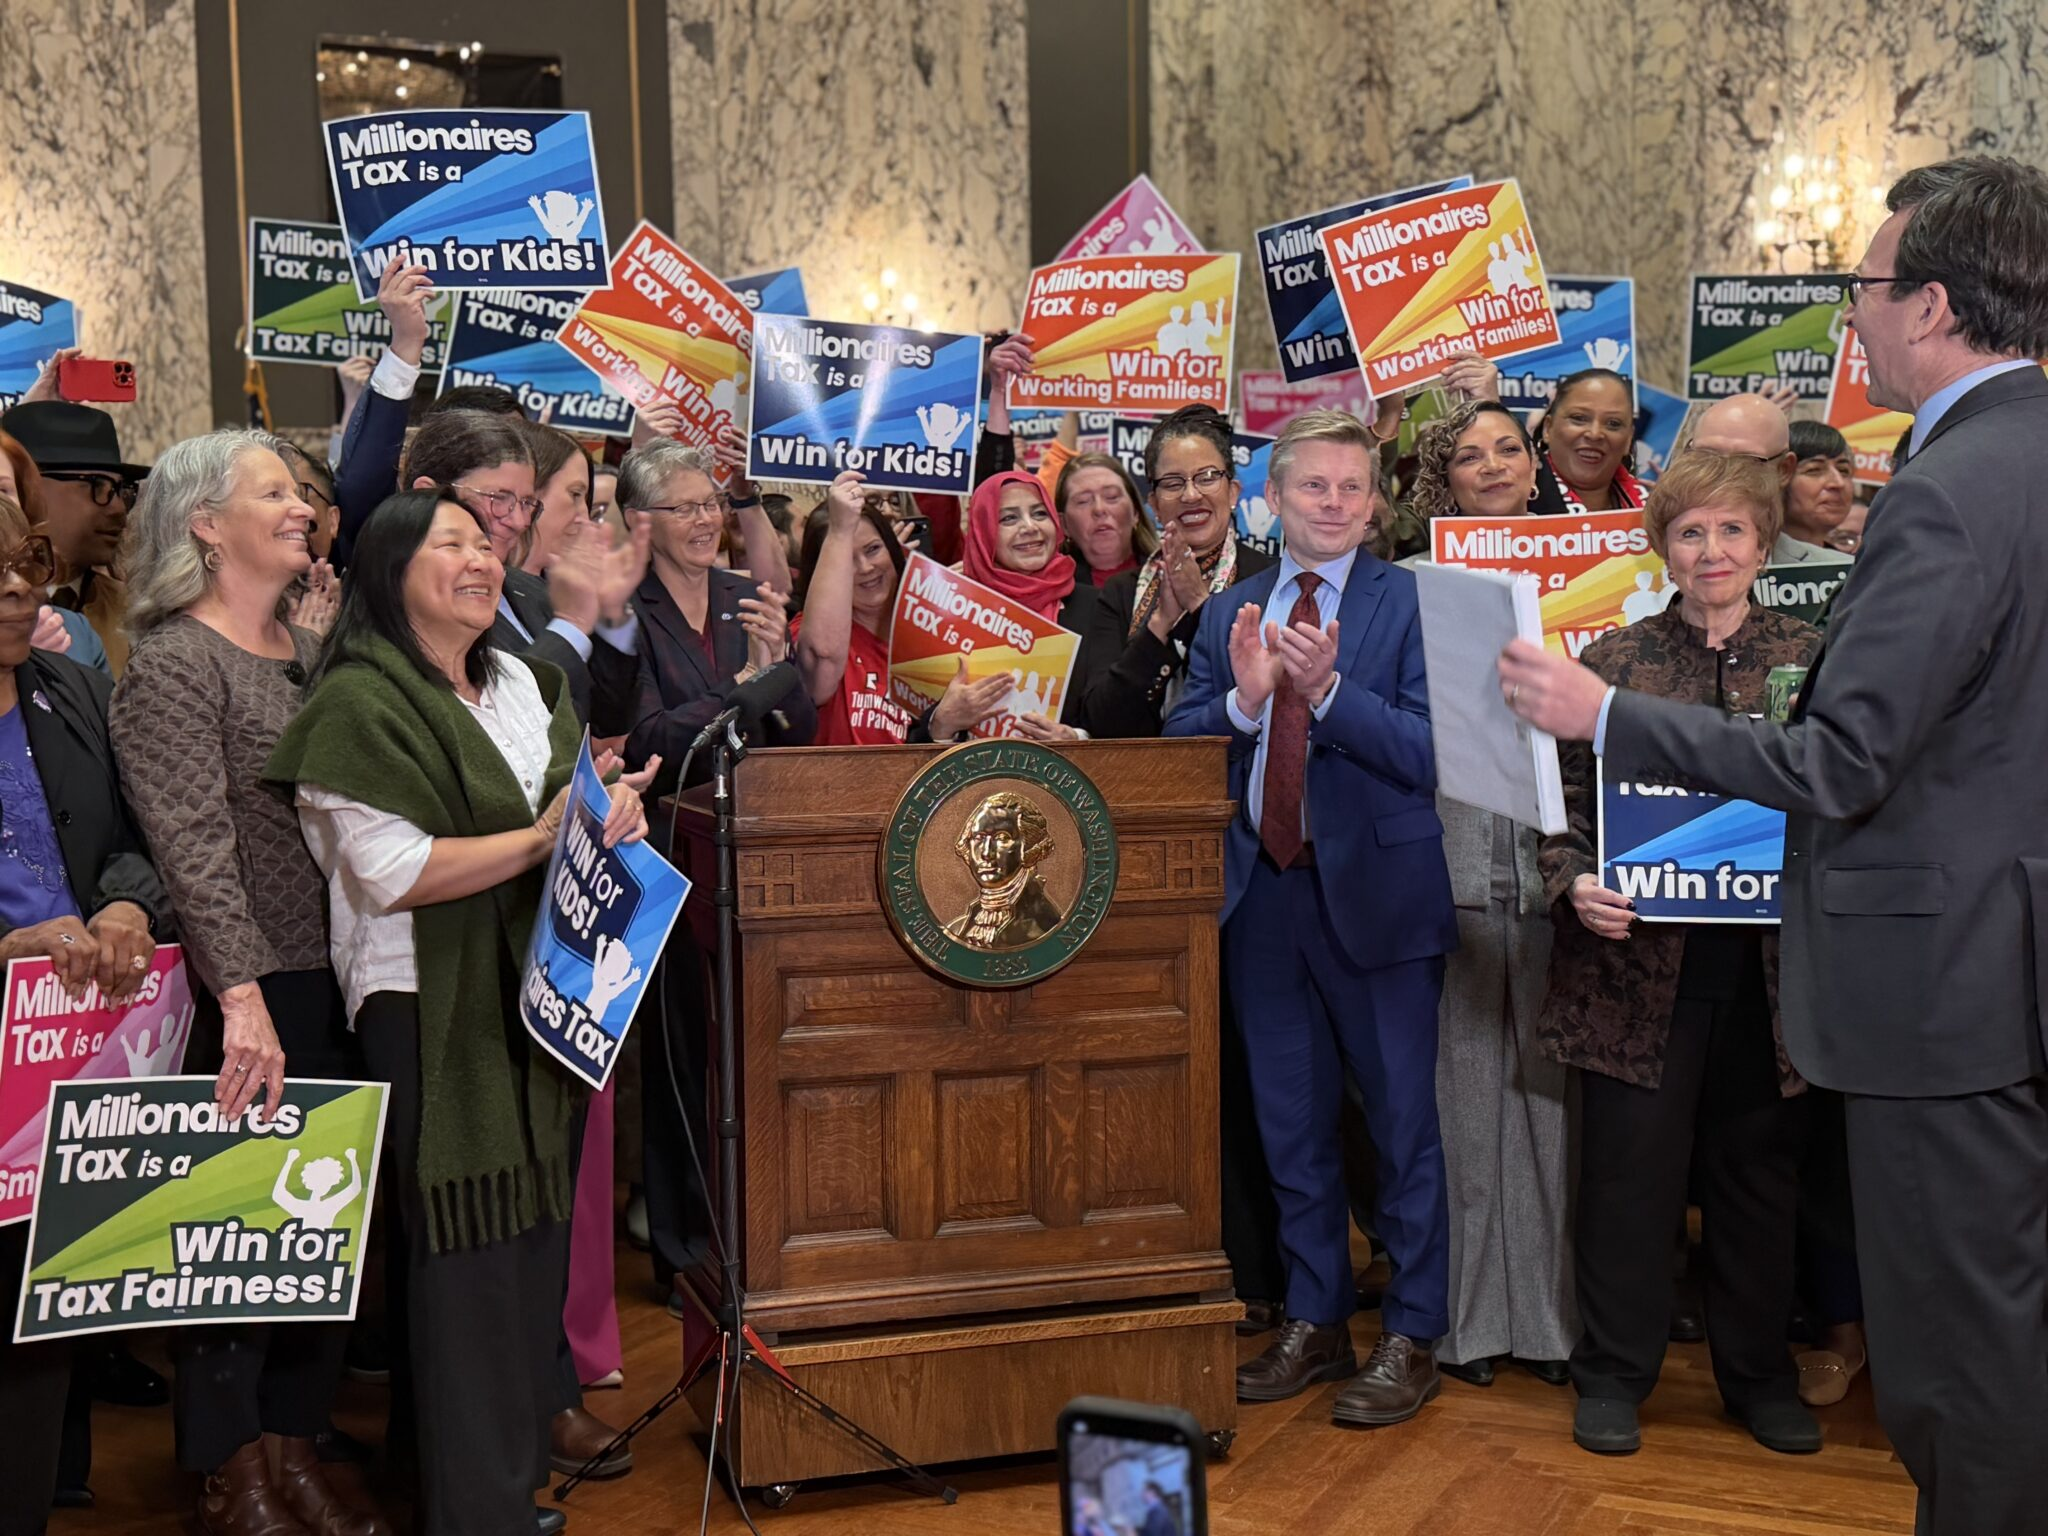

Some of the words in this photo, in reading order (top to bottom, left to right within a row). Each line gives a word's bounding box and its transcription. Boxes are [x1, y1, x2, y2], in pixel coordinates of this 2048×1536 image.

[338, 119, 533, 160] Millionaires
[342, 159, 411, 189] Tax
[419, 161, 440, 181] is
[445, 165, 461, 181] a
[1333, 202, 1489, 266] Millionaires
[259, 254, 310, 280] Tax
[316, 265, 333, 283] is
[336, 271, 350, 283] a
[361, 239, 437, 279] Win
[443, 241, 494, 272] for
[501, 240, 596, 272] Kids!
[1268, 260, 1319, 291] Tax
[1342, 255, 1406, 292] Tax
[1411, 253, 1430, 274] is
[1432, 250, 1447, 266] a
[621, 256, 672, 309] Tax
[668, 303, 686, 325] is
[686, 323, 702, 337] a
[1034, 262, 1185, 297] Millionaires
[1700, 280, 1841, 304] Millionaires
[465, 301, 516, 333] Tax
[520, 320, 537, 338] is
[540, 327, 555, 341] a
[1030, 296, 1075, 320] Tax
[1081, 298, 1098, 316] is
[1102, 302, 1117, 317] a
[1459, 291, 1510, 327] Win
[1510, 285, 1542, 316] for
[1697, 305, 1745, 326] Tax
[1750, 311, 1765, 326] is
[1768, 313, 1783, 326] a
[257, 329, 312, 353] Tax
[765, 327, 932, 366] Millionaires
[1476, 312, 1552, 349] Families!
[572, 322, 657, 403] Working
[1110, 348, 1175, 378] Win
[1176, 352, 1219, 378] for
[1286, 333, 1344, 368] Win
[1776, 350, 1828, 371] Win
[765, 355, 820, 384] Tax
[826, 367, 845, 387] is
[849, 375, 865, 388] a
[1017, 377, 1112, 404] Working
[1116, 380, 1222, 401] Families!
[1498, 373, 1521, 397] in
[1524, 373, 1556, 397] for
[1694, 374, 1743, 394] Tax
[518, 383, 559, 410] for
[560, 393, 631, 421] Kids!
[663, 366, 711, 422] Win
[708, 413, 732, 443] fo
[760, 436, 827, 467] Win
[835, 441, 877, 470] for
[883, 446, 964, 477] Kids!
[1445, 523, 1648, 560] Millionaires
[1548, 573, 1566, 589] a
[904, 594, 943, 636] Tax
[943, 624, 959, 645] is
[961, 638, 974, 652] a
[908, 567, 1034, 651] Millionaires
[851, 709, 864, 728] of
[964, 749, 1040, 775] STATE
[1044, 762, 1076, 788] OF
[914, 762, 963, 808] THE
[899, 806, 924, 843] OF
[566, 810, 597, 880] WIN
[589, 857, 624, 909] for
[1057, 785, 1110, 950] WASHINGTON
[554, 859, 599, 940] KIDS!
[892, 851, 918, 914] SEAL
[1615, 862, 1706, 899] Win
[1716, 864, 1779, 900] for
[908, 919, 950, 962] THE
[11, 1024, 68, 1065] Tax
[71, 1028, 89, 1058] is
[91, 1031, 104, 1053] a
[564, 1003, 614, 1067] Tax
[59, 1091, 301, 1140] Millionaires
[55, 1144, 131, 1184] Tax
[137, 1149, 164, 1178] is
[169, 1154, 192, 1178] a
[175, 1221, 268, 1263] Win
[279, 1227, 345, 1262] for
[33, 1281, 116, 1322] Tax
[121, 1265, 344, 1311] Fairness!
